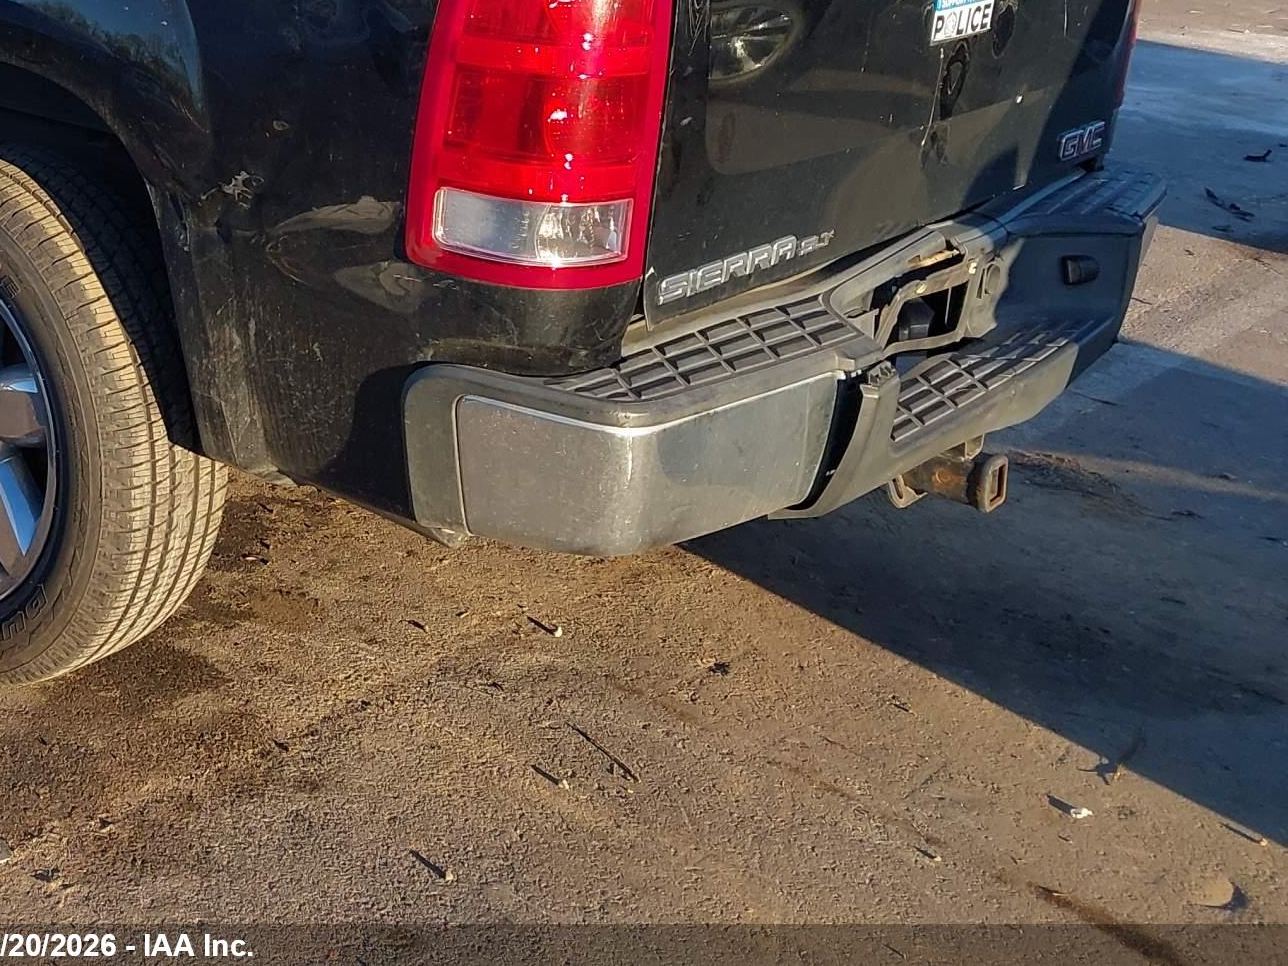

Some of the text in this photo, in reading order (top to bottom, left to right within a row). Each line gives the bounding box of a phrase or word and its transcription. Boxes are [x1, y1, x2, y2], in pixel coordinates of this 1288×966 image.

[1059, 121, 1106, 162] GMC
[658, 229, 836, 306] SIERRA SLT
